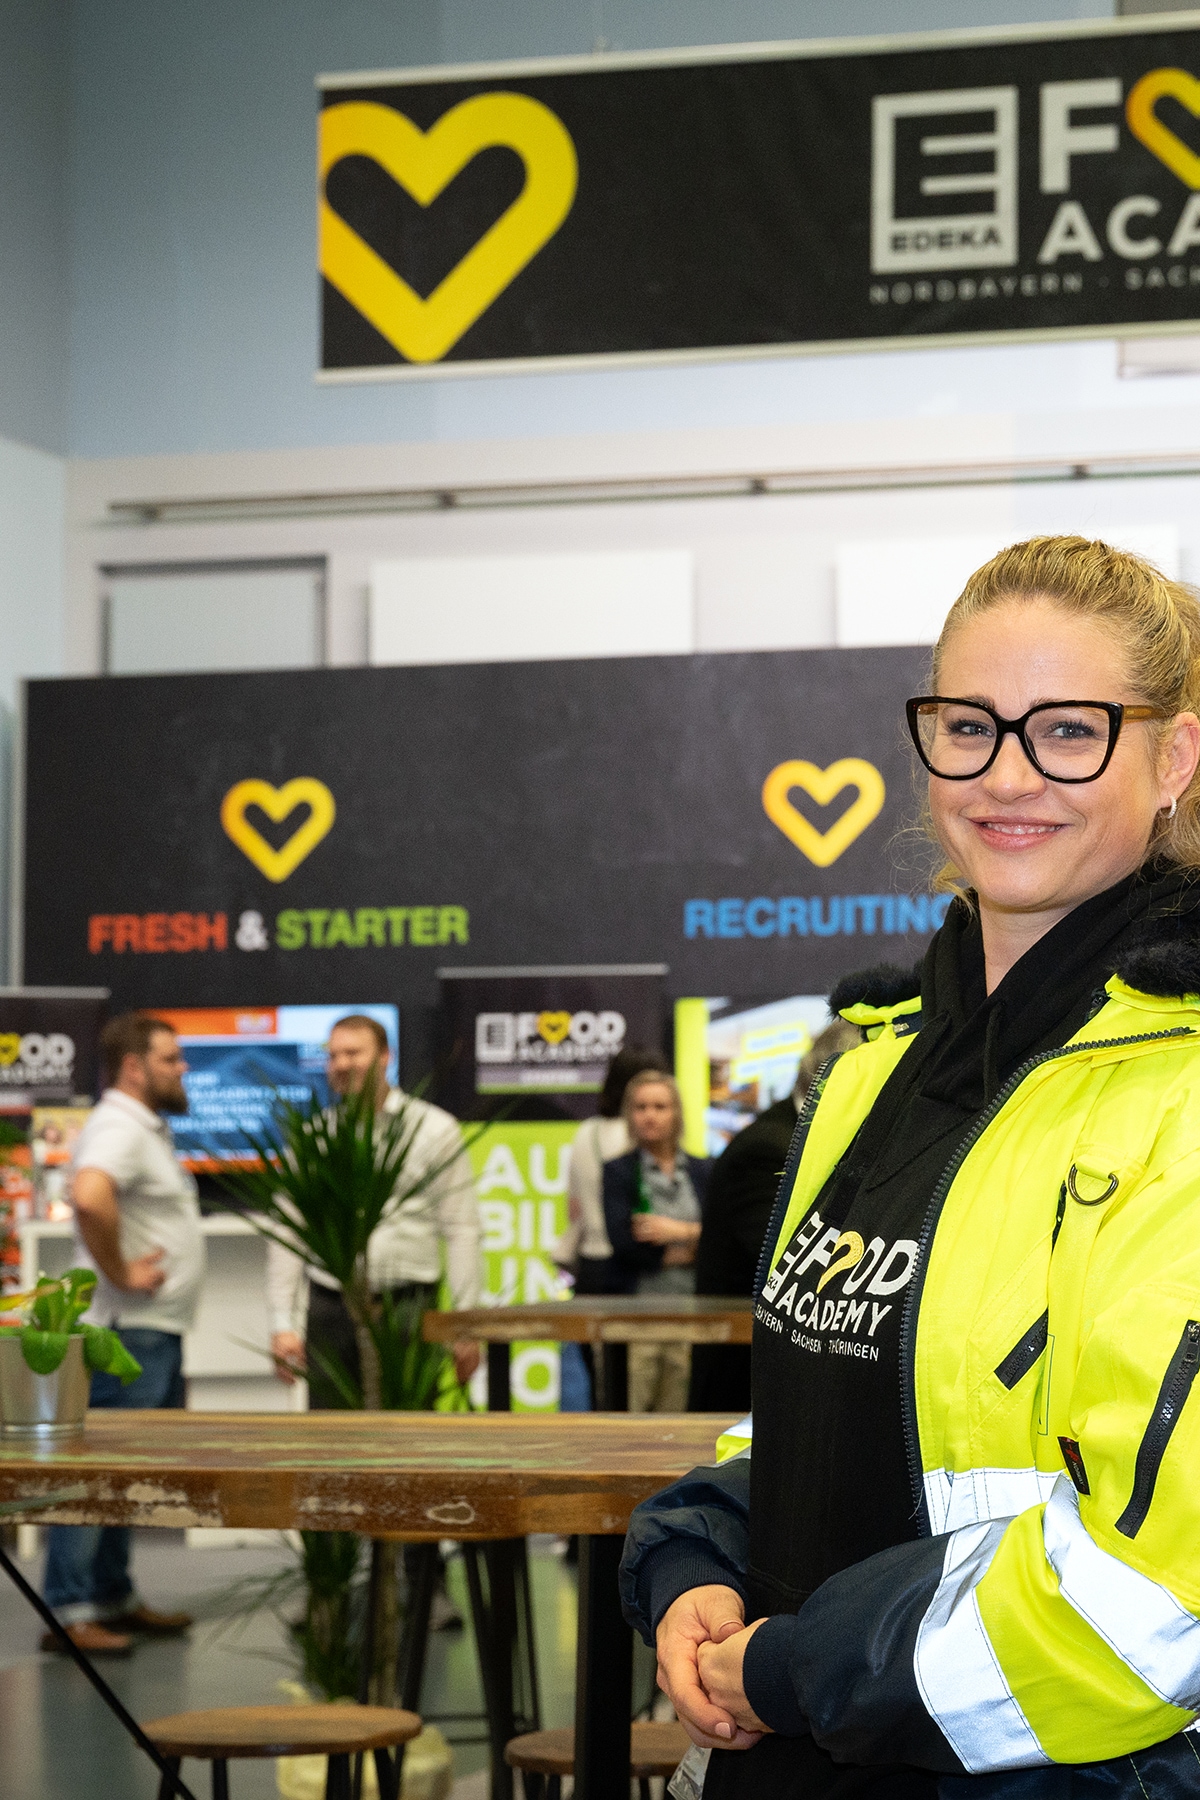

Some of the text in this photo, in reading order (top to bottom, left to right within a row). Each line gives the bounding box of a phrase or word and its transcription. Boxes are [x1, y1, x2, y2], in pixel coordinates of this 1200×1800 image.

[889, 226, 1002, 254] EDEKA
[869, 271, 1085, 305] NORDBAYERN
[88, 905, 471, 953] FRESH & STARTER
[774, 1281, 893, 1337] ACADEMY
[790, 1329, 822, 1354] SACHSEN
